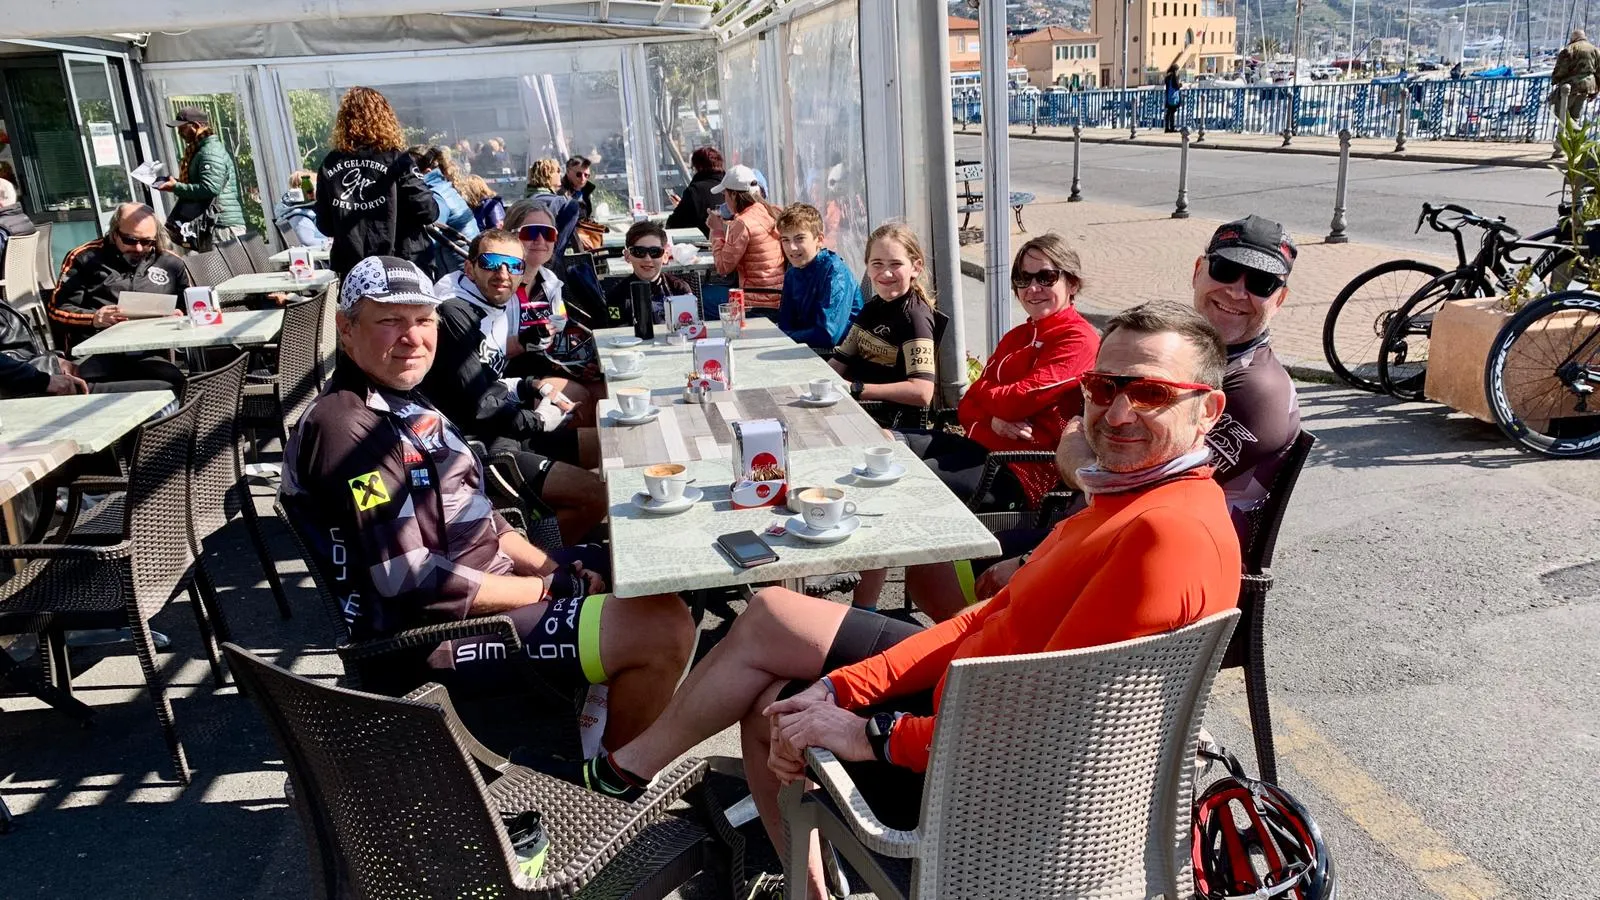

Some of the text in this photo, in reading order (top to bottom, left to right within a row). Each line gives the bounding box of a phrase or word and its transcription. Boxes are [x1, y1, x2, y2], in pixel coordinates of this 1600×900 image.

[327, 159, 389, 178] BAR GELATERIA
[332, 195, 386, 211] DEL PORTO
[152, 273, 165, 282] 66
[455, 642, 576, 664] SIMLON
